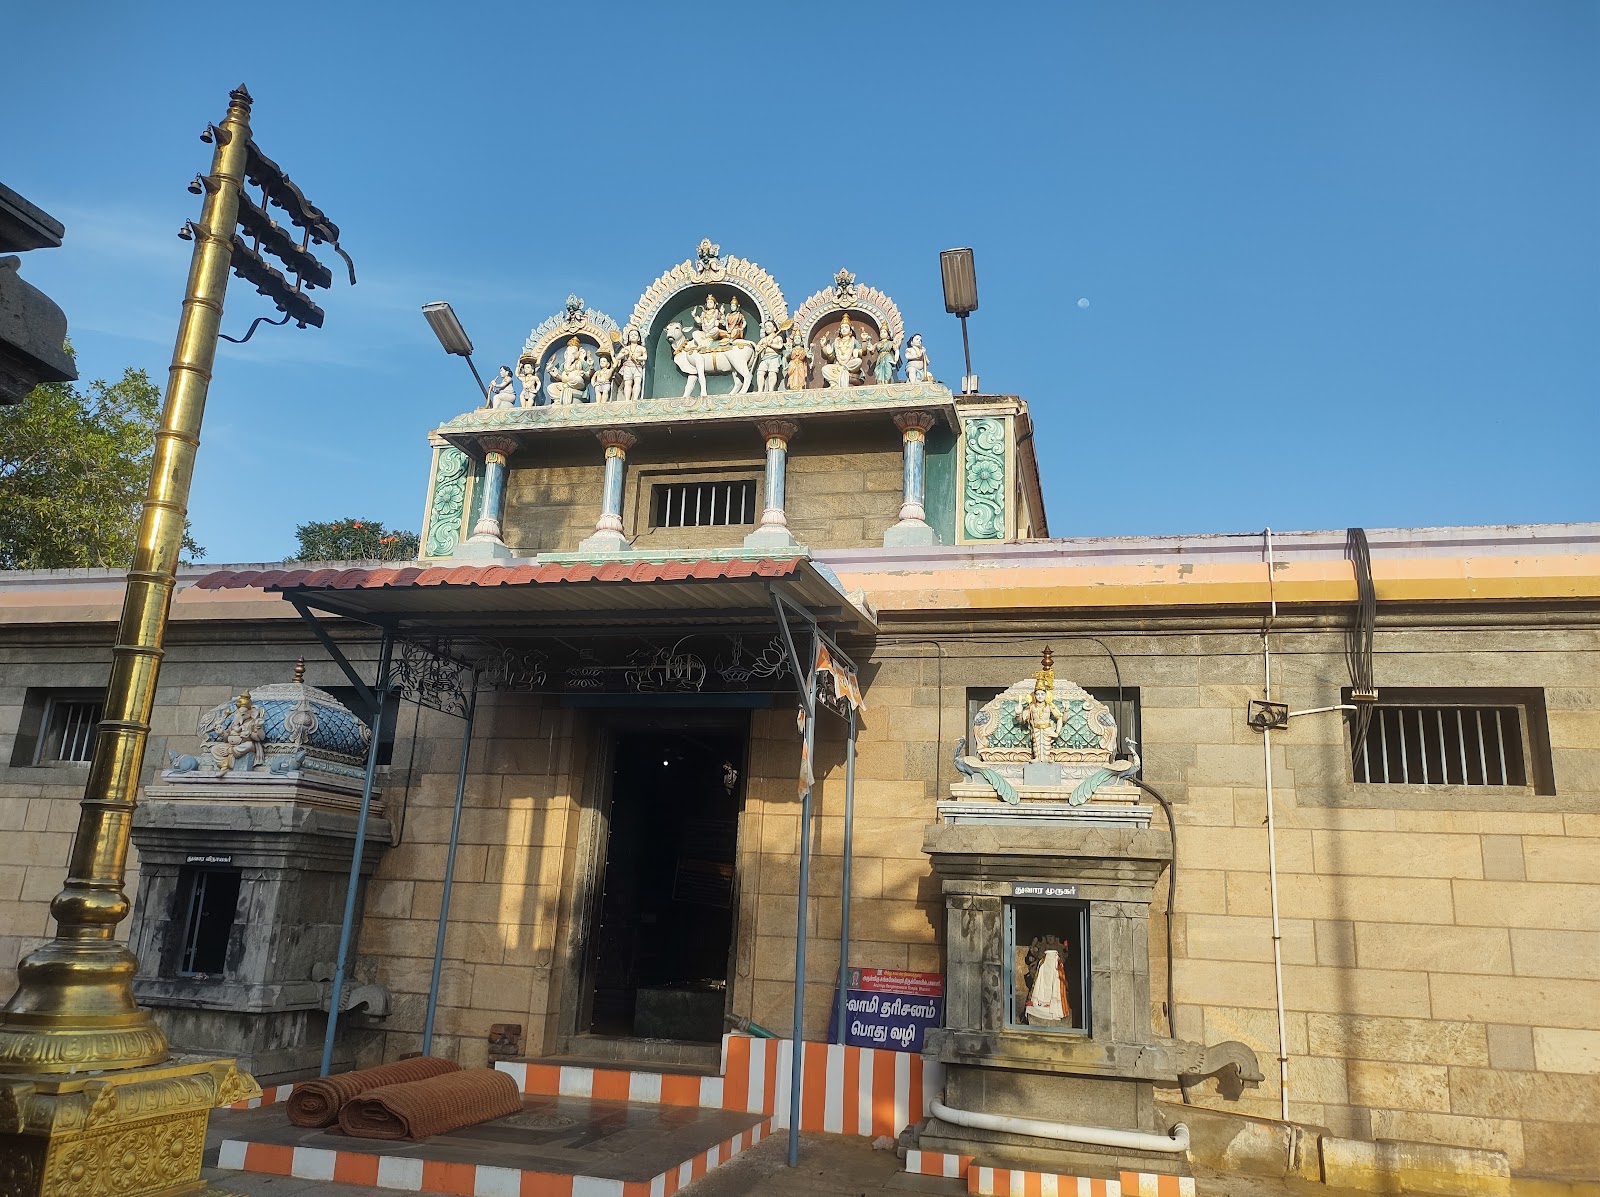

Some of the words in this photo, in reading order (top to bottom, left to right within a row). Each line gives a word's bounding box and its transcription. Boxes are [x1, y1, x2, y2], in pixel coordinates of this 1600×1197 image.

[1015, 886, 1043, 895] துவார
[1045, 886, 1076, 896] முருகர்
[838, 995, 879, 1013] வாமி
[880, 998, 935, 1018] தரிசனம்
[851, 1020, 888, 1042] பொது
[890, 1024, 916, 1047] வழி
